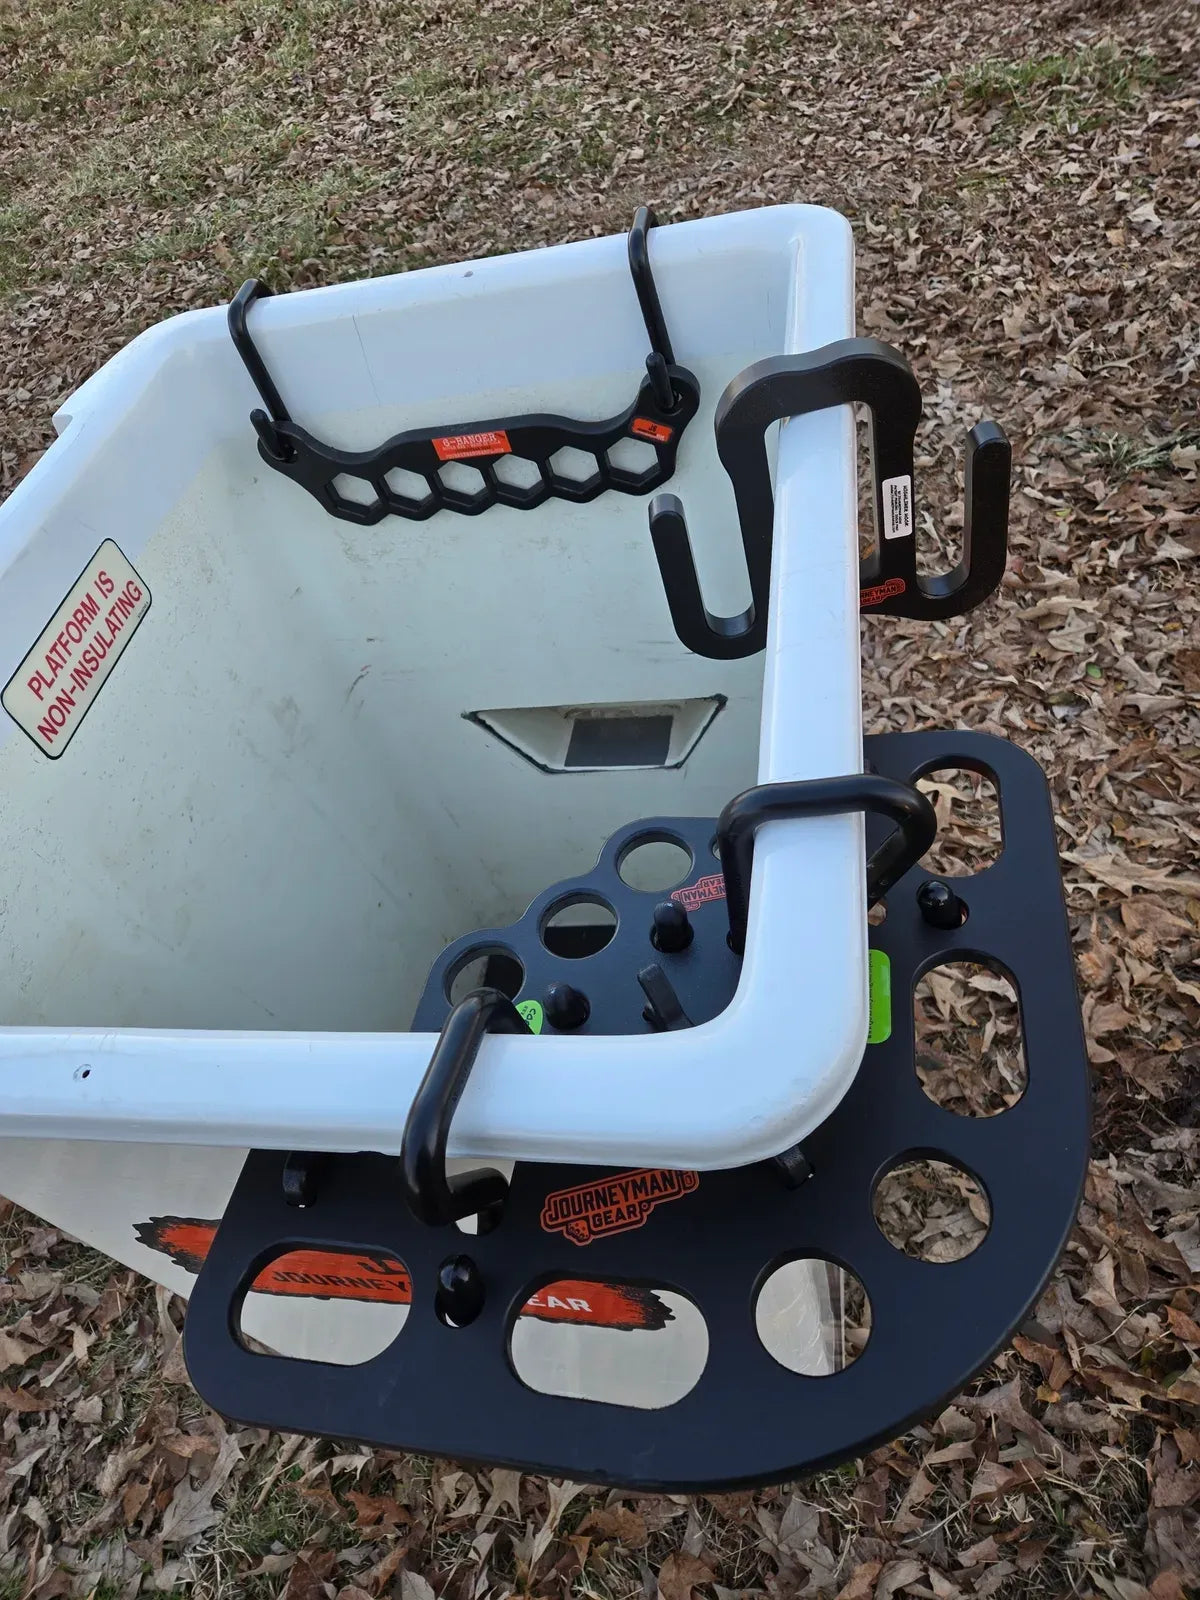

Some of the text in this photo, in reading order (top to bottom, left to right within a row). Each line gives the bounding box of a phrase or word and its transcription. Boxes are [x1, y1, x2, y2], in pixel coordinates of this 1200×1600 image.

[27, 570, 115, 701] PLATFORM IS
[37, 580, 143, 743] NON-INSULATING
[683, 886, 726, 902] NEYMAN
[550, 1170, 676, 1222] JOURNEYMAN
[592, 1204, 638, 1228] GEAR
[272, 1272, 593, 1312] JOURNEY EAR
